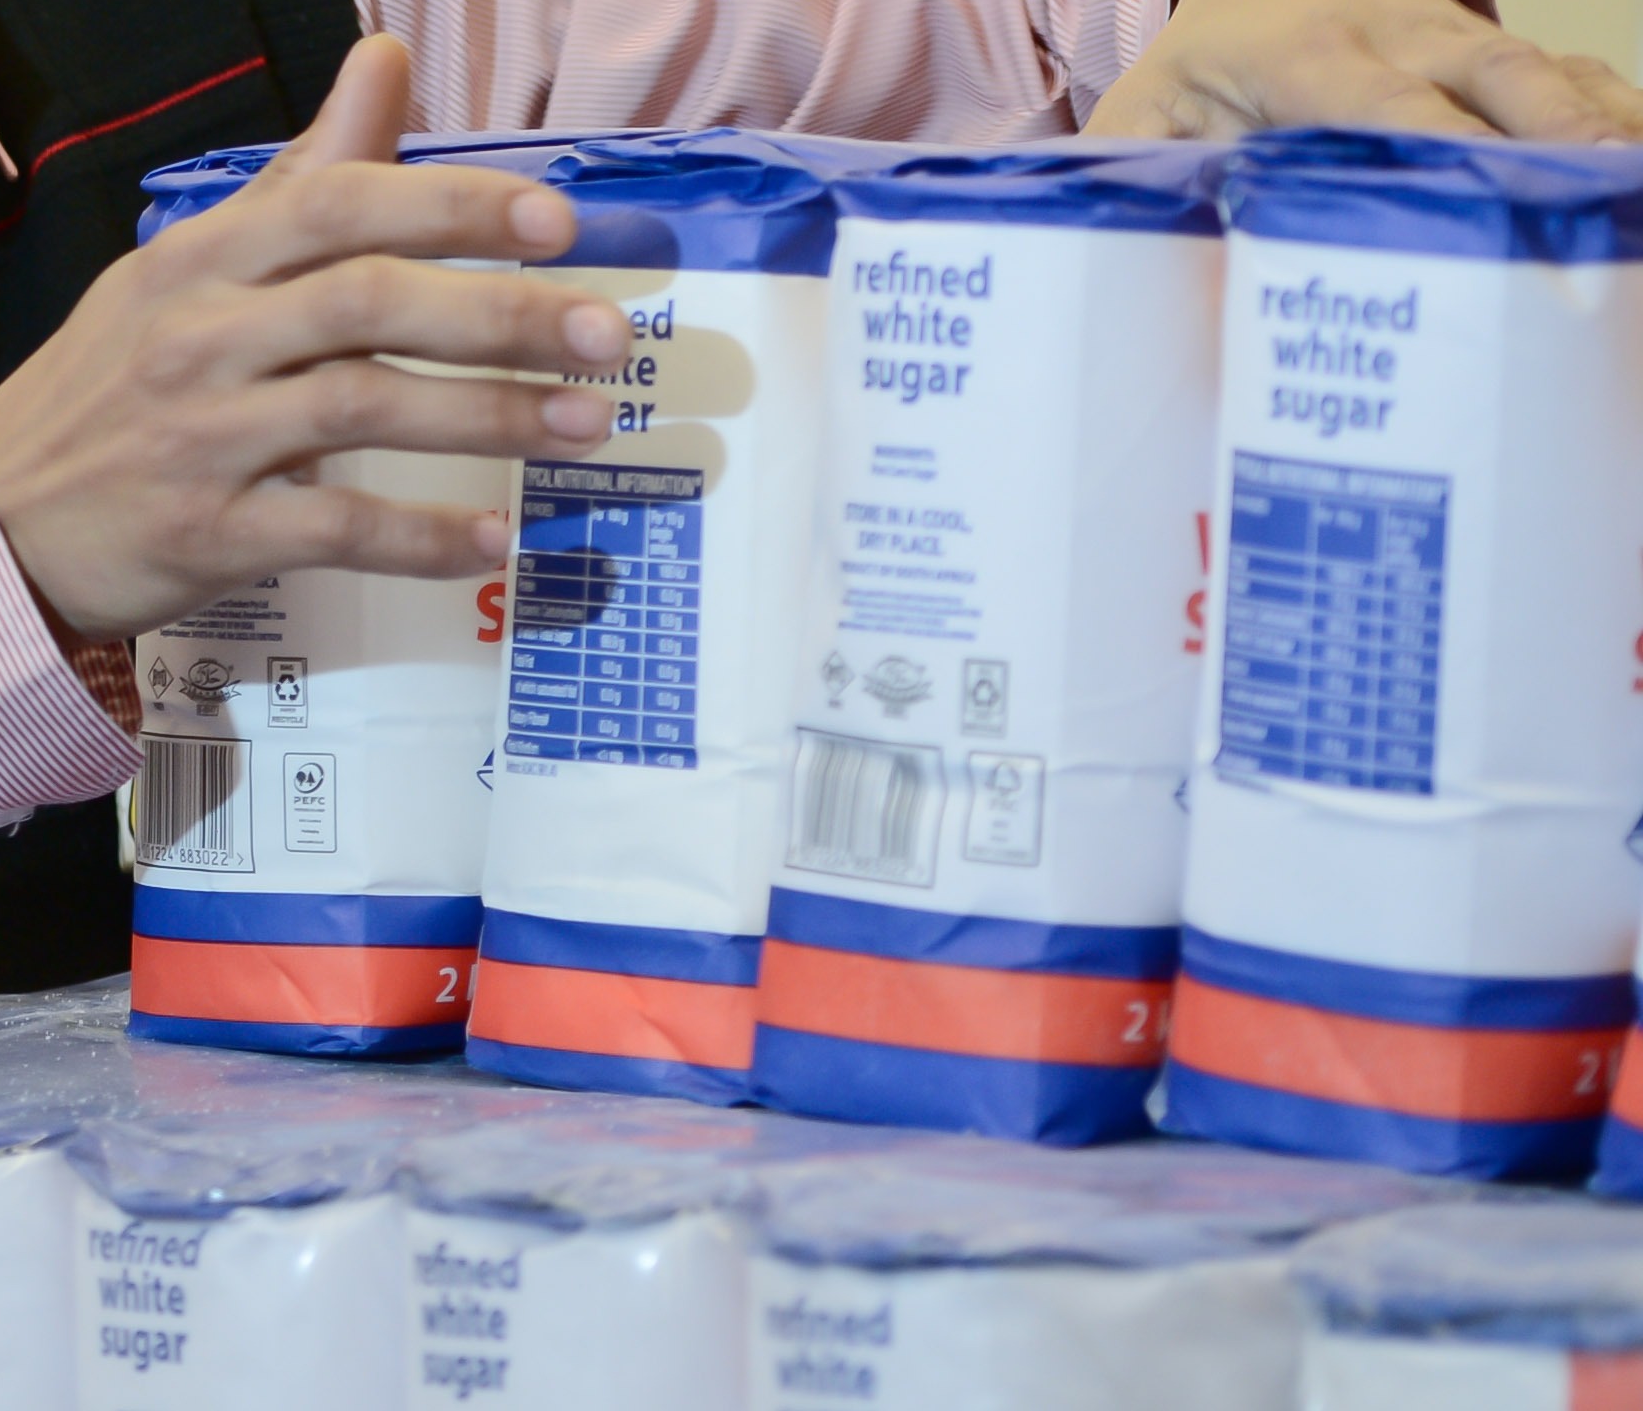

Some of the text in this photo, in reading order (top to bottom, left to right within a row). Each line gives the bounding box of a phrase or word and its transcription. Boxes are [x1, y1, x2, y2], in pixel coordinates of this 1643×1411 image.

[854, 251, 992, 299] refined
[863, 300, 972, 347] white
[1260, 278, 1420, 332] refined
[1273, 331, 1396, 382] white
[863, 357, 971, 404] sugar
[1271, 386, 1394, 438] sugar
[294, 796, 326, 806] PEFC
[179, 849, 229, 867] 883022
[435, 966, 458, 1003] 2
[1122, 1001, 1149, 1044] 2
[1574, 1052, 1601, 1096] 2
[89, 1220, 207, 1269] refined
[99, 1269, 185, 1317] white
[422, 1294, 506, 1341] white
[100, 1322, 188, 1371] sugar
[422, 1349, 510, 1399] sugar
